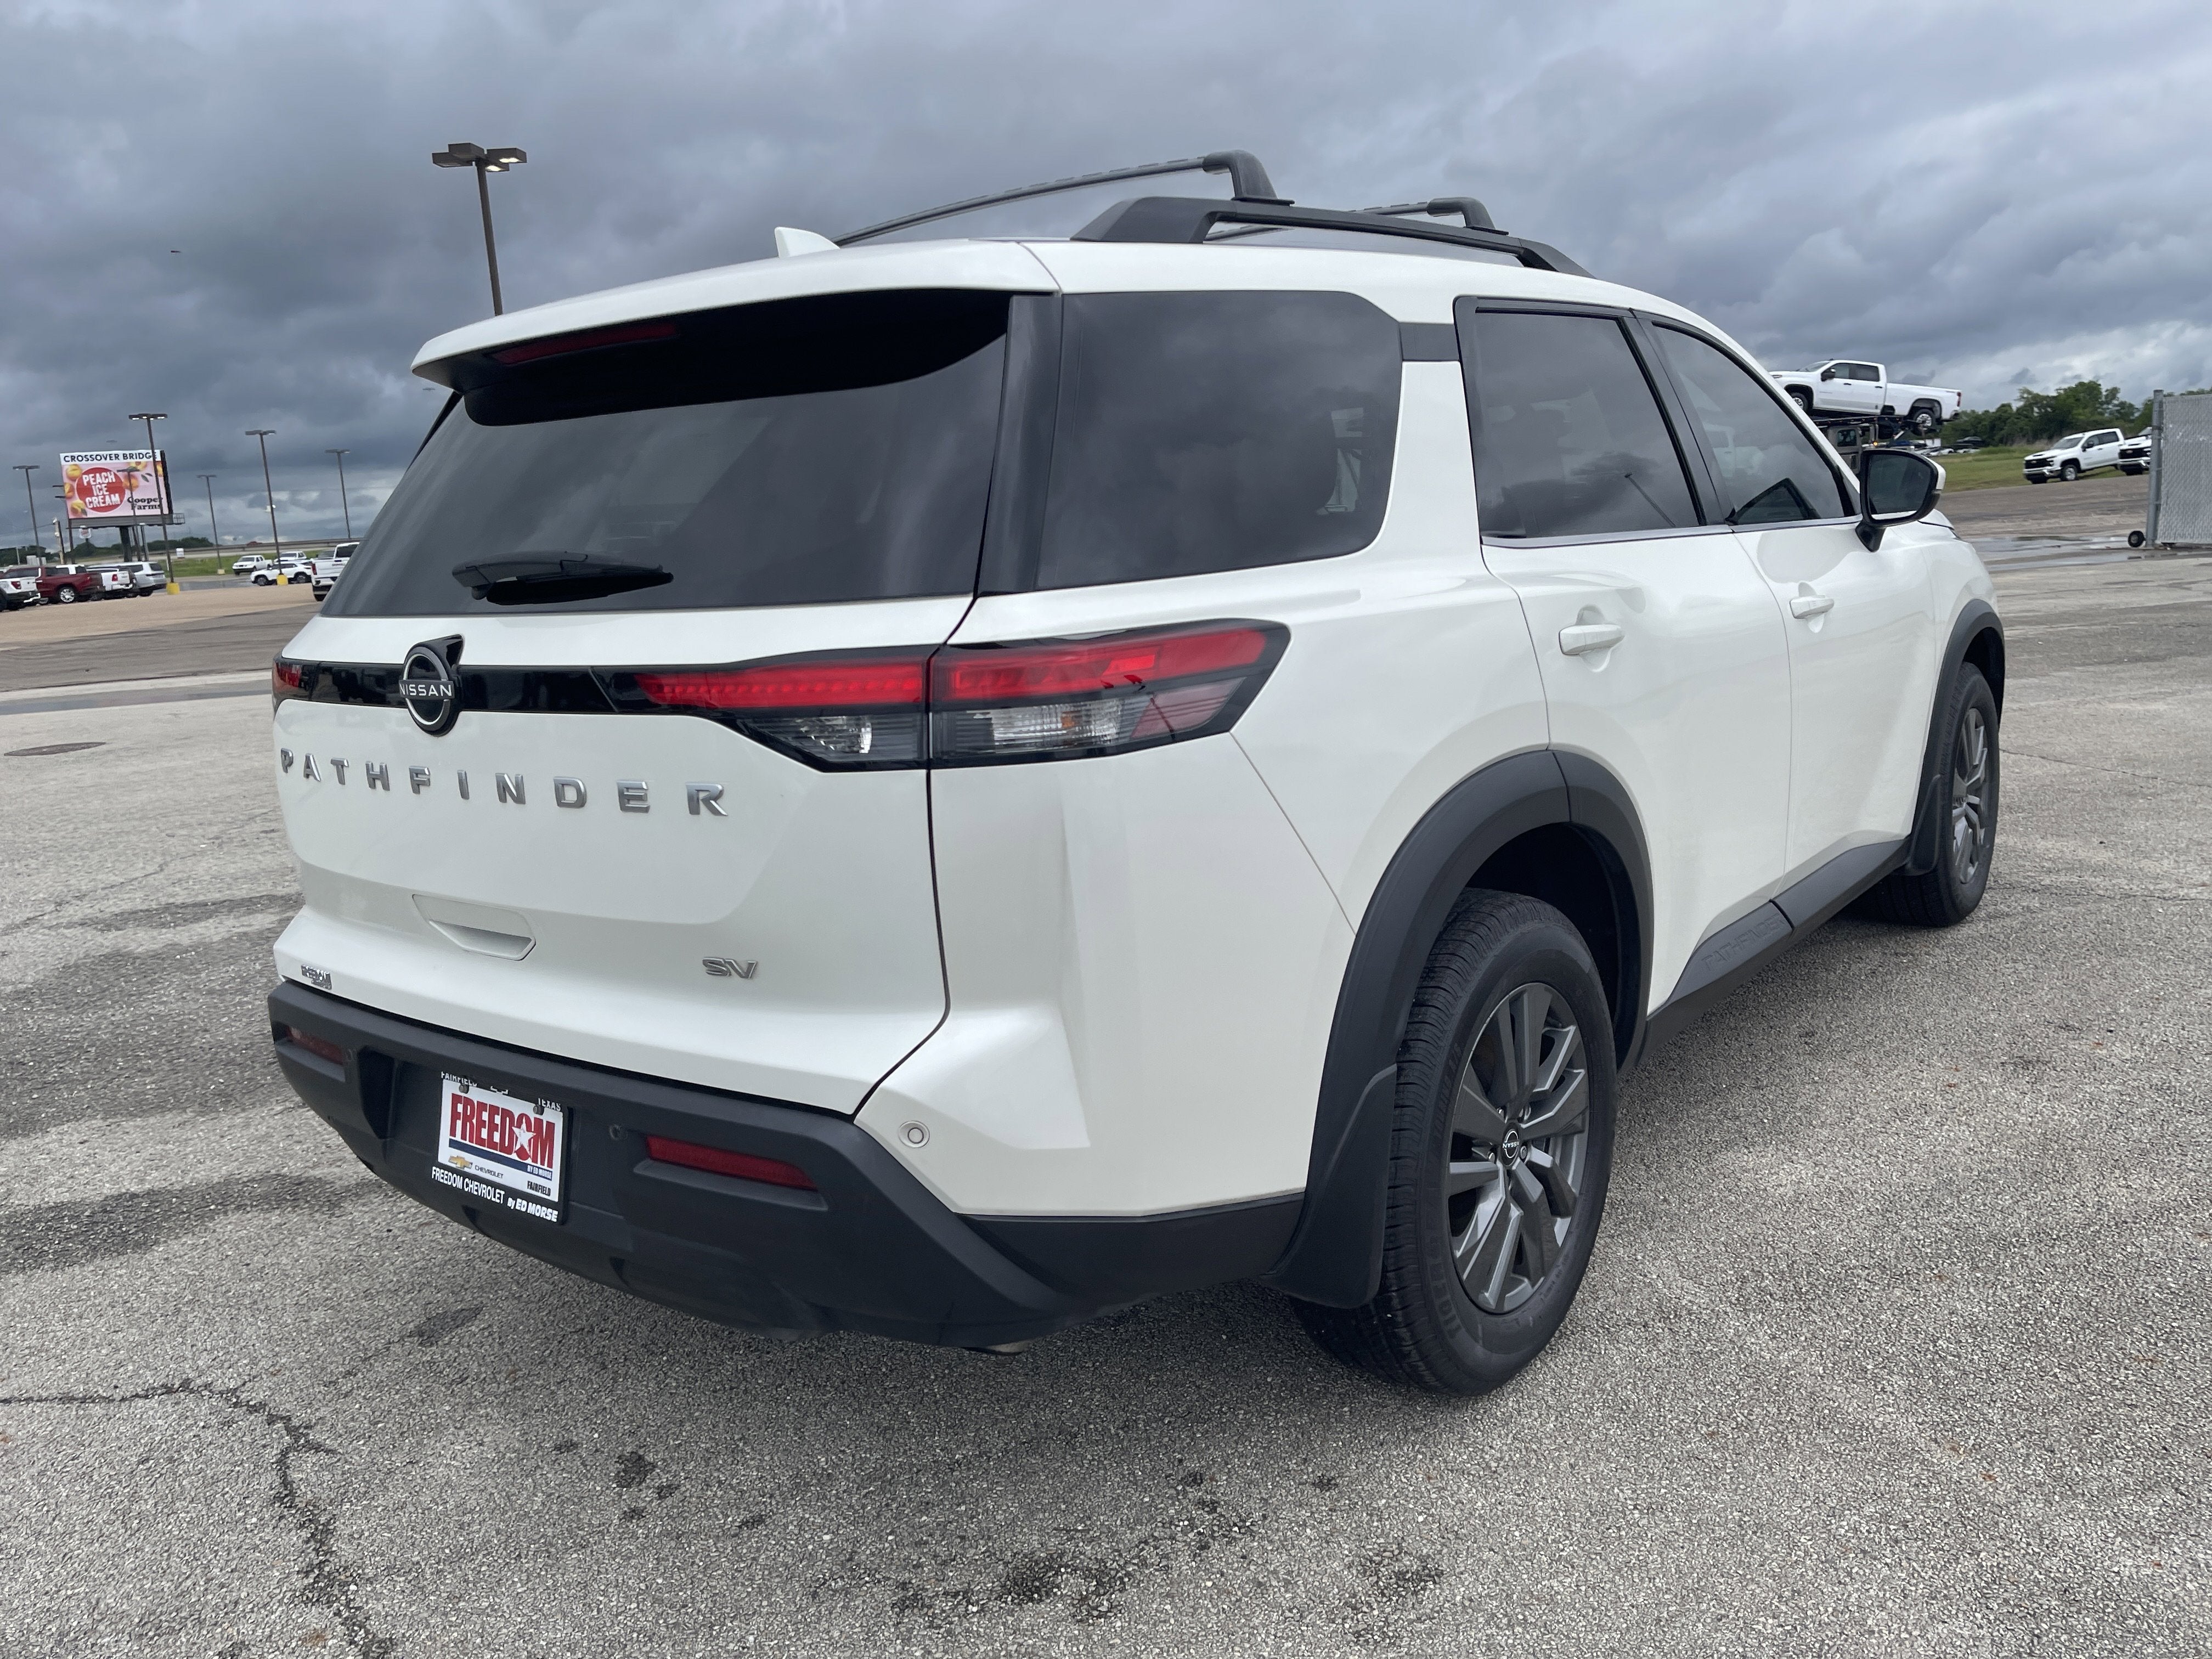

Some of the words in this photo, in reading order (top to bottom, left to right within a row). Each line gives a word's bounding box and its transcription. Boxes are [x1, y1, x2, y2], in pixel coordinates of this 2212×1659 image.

[63, 453, 120, 462] CROSSOVER
[82, 471, 116, 486] PEACH
[92, 484, 109, 496] ICE
[85, 494, 121, 509] CREAM
[399, 683, 452, 696] NISSAN
[280, 748, 729, 816] PATHFINDER
[702, 957, 758, 979] SV
[538, 1098, 561, 1111] TEXAS
[449, 1092, 555, 1169] FREEDOM
[475, 1165, 504, 1179] CHEVROLET
[431, 1166, 463, 1189] FREEDOM
[464, 1178, 505, 1204] CHEVROLET
[516, 1198, 527, 1211] ED
[527, 1202, 558, 1222] MORSE
[527, 1180, 551, 1197] FAIRFIELD
